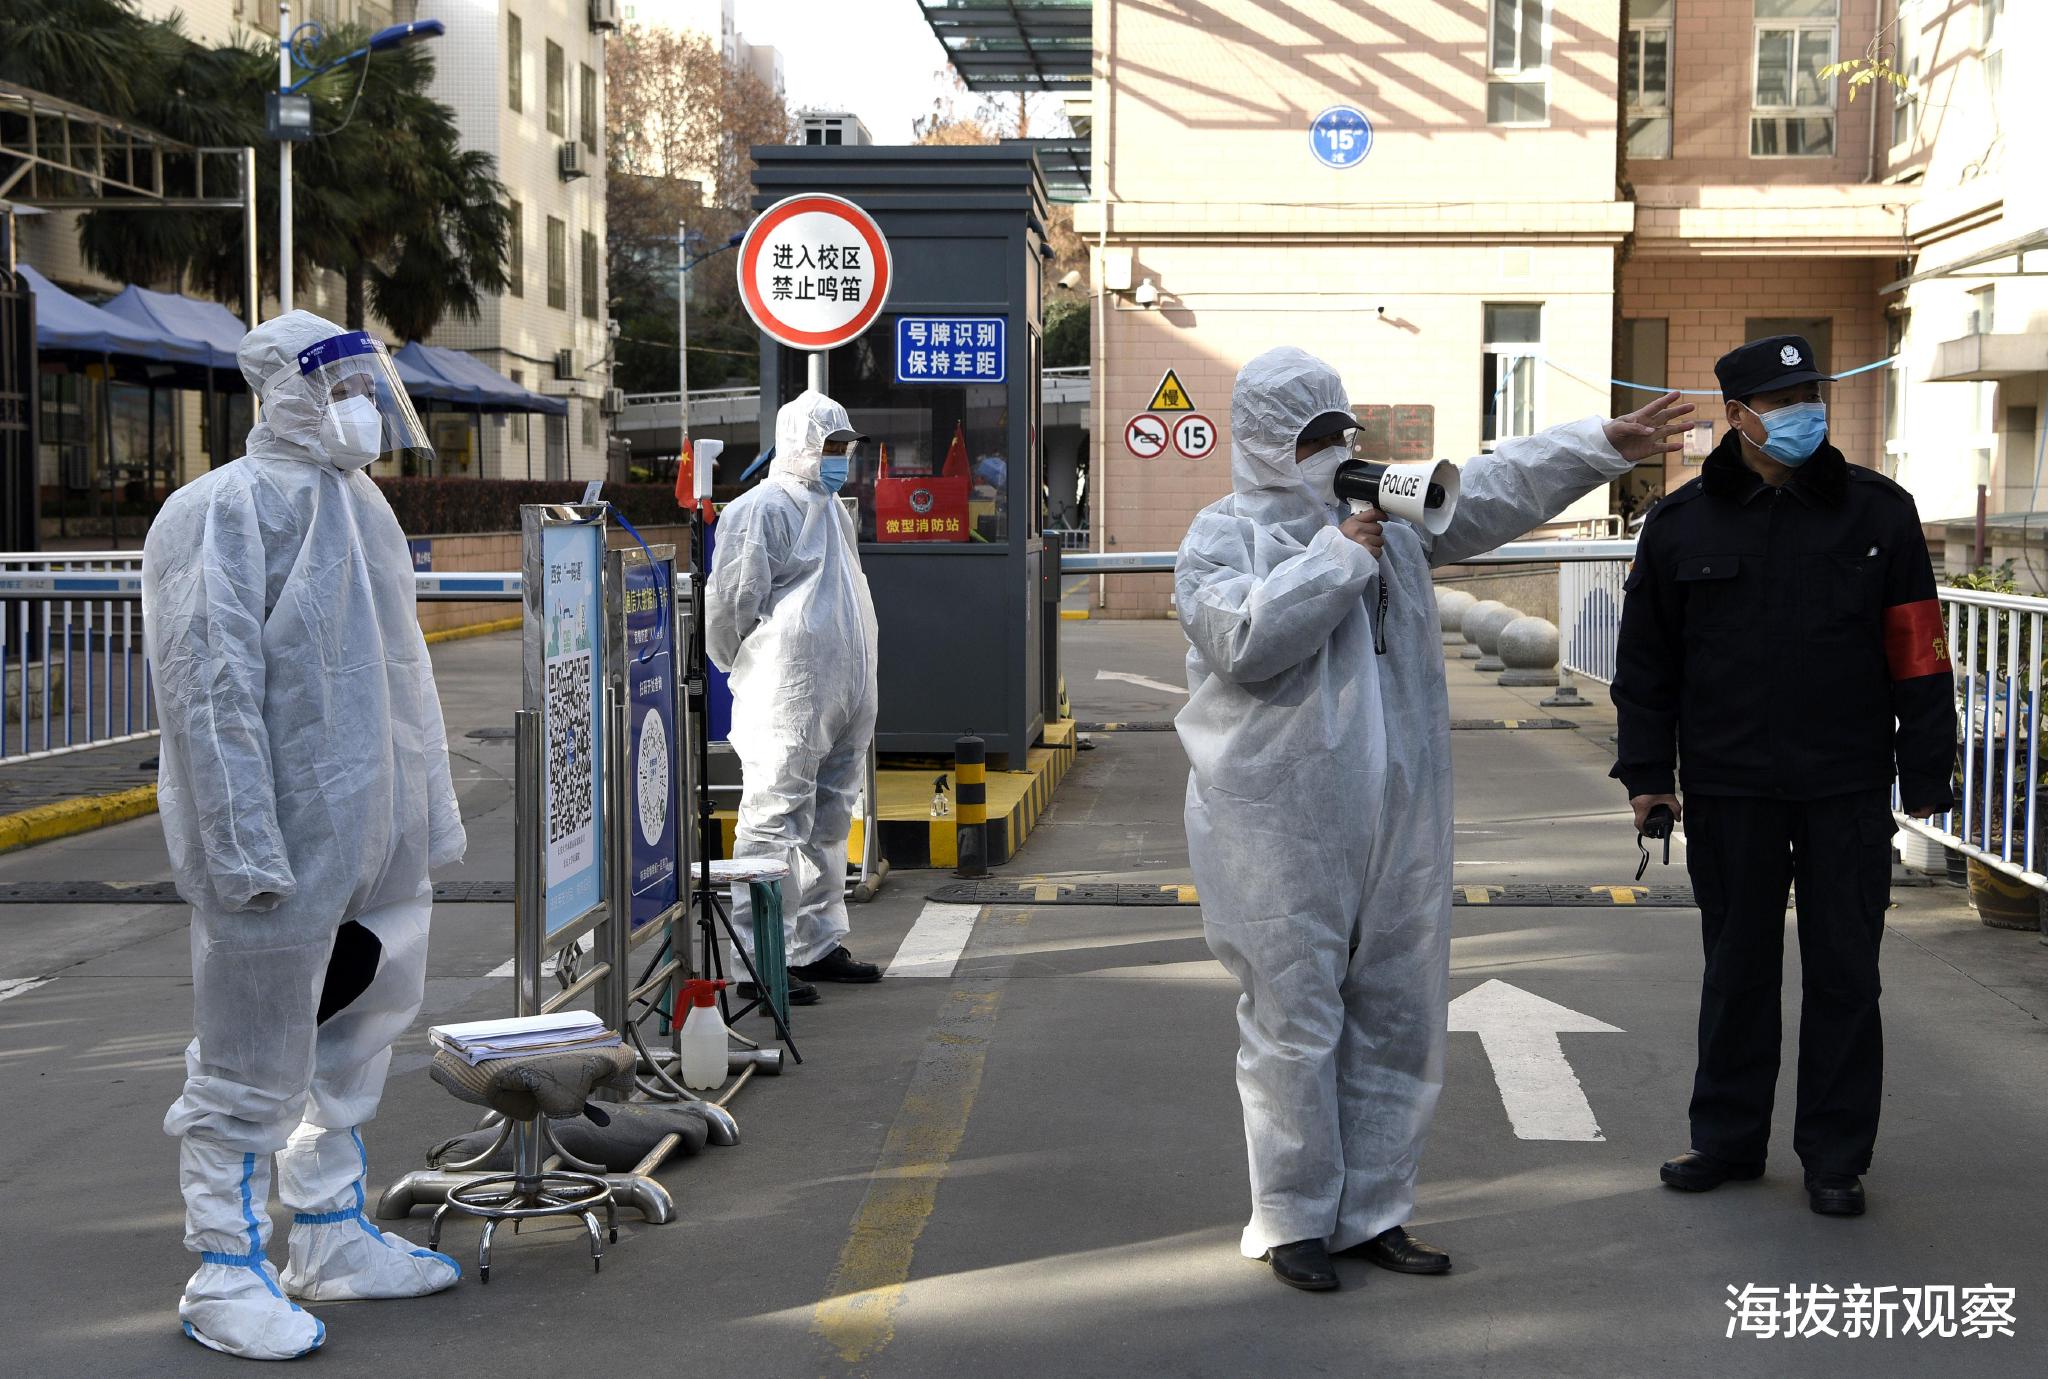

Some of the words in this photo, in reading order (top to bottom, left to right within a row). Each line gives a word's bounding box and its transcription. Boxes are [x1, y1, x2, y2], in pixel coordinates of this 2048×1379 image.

[1326, 129, 1354, 150] 15
[773, 245, 861, 270] 进入校区
[772, 275, 862, 301] 禁止鸣笛
[907, 322, 996, 347] 号牌识别
[907, 350, 997, 375] 保持车距
[1162, 389, 1179, 406] 慢
[1184, 426, 1206, 449] 15
[1382, 473, 1420, 497] POLICE
[886, 517, 960, 534] 微型消防站
